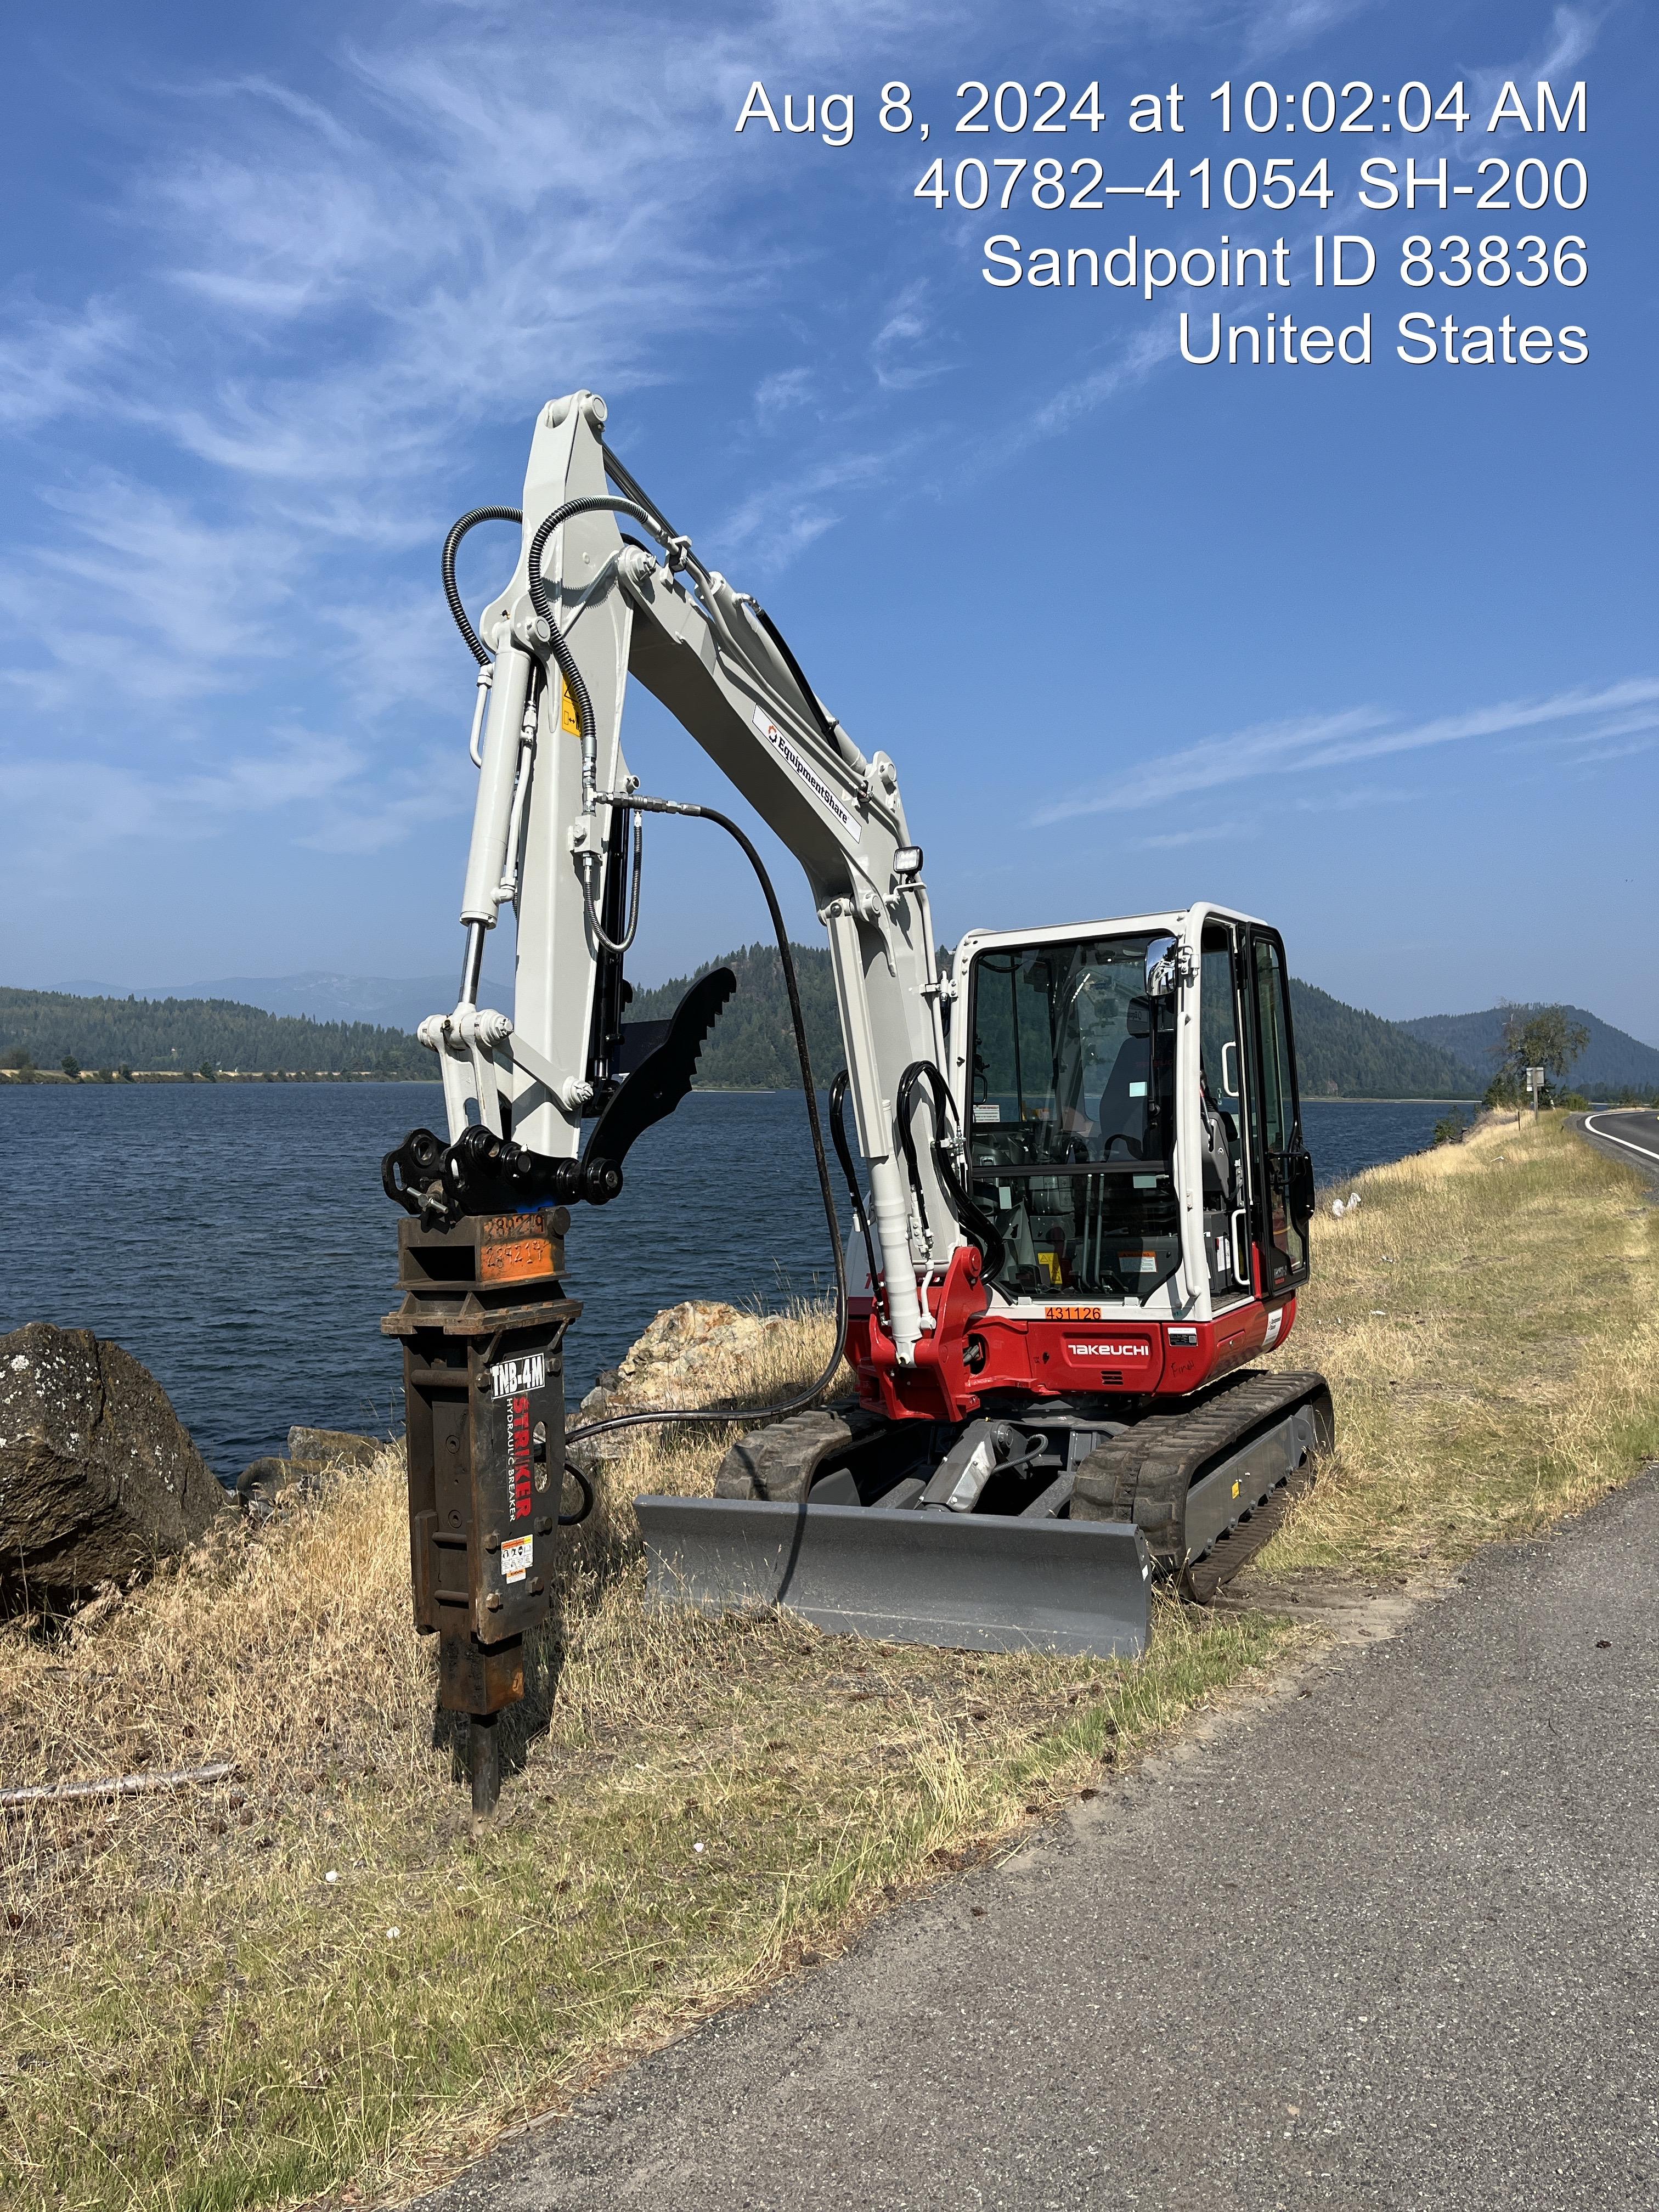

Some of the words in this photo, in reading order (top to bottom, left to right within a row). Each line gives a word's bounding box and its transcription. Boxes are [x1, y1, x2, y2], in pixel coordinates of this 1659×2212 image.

[778, 736, 848, 823] EquipmentShare
[1046, 1307, 1101, 1320] 431126
[492, 1356, 543, 1397] TNB-4M
[506, 1398, 515, 1465] HYDRAULIC
[513, 1396, 532, 1521] STRIKER
